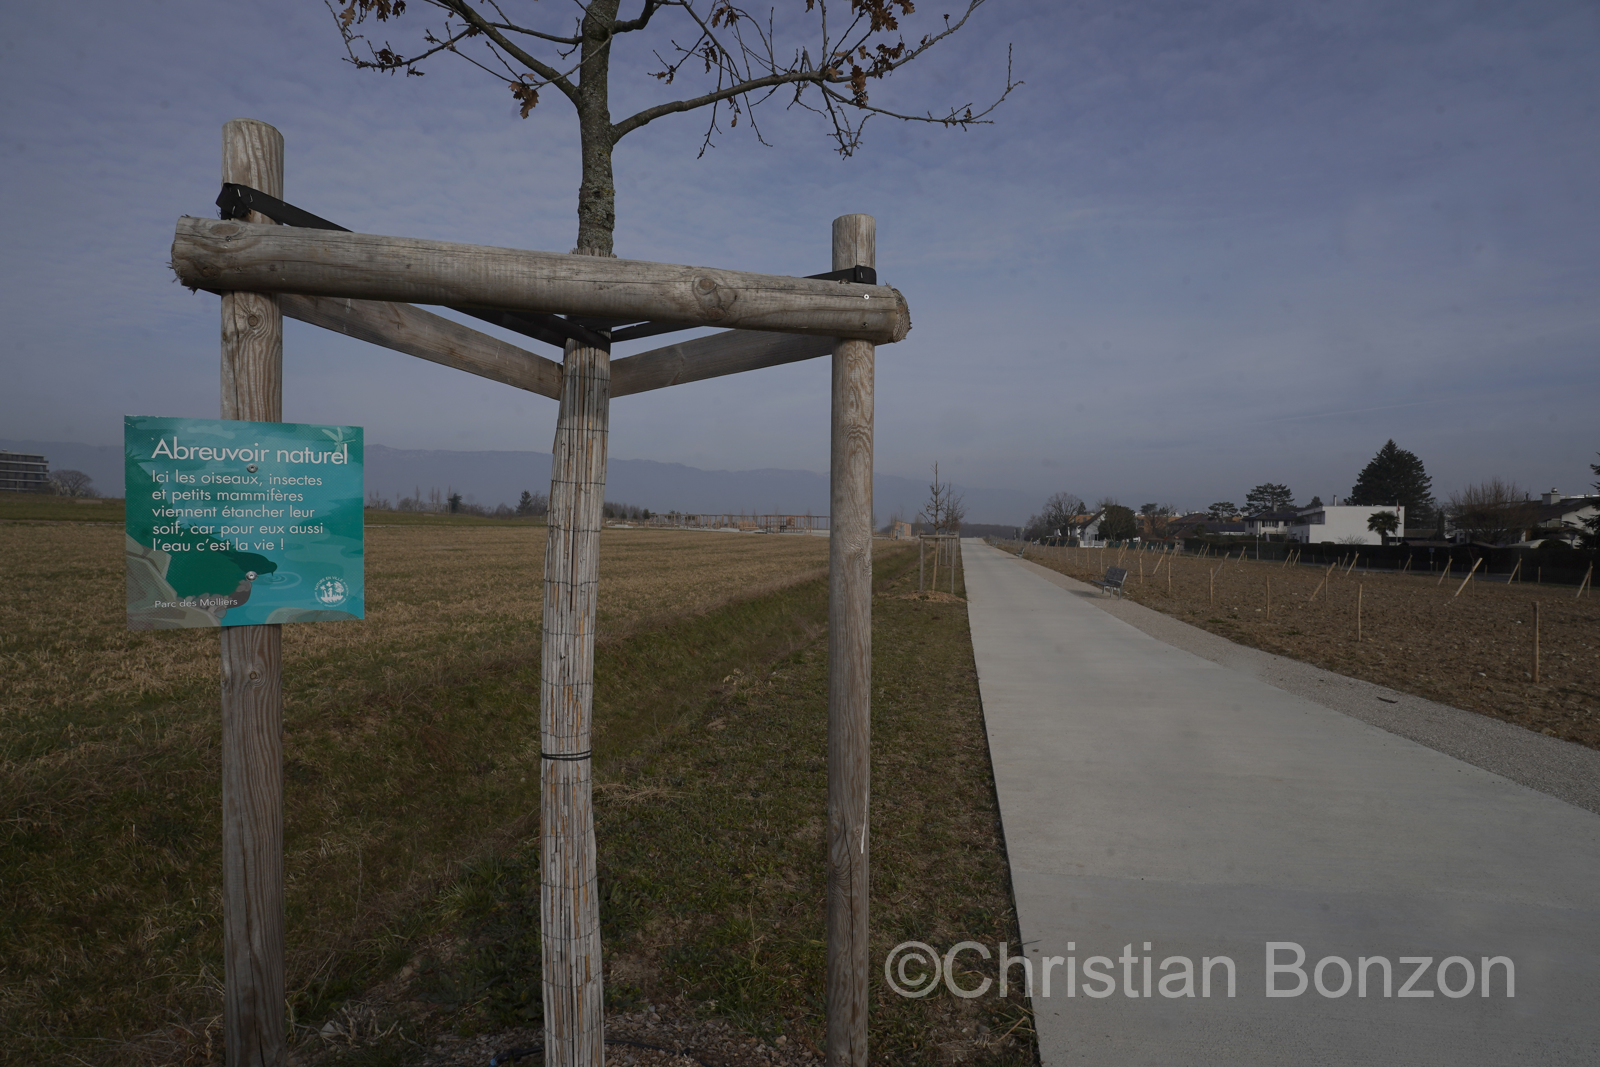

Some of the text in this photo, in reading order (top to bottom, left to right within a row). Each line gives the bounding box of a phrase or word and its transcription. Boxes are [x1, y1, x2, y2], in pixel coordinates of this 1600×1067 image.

[151, 436, 349, 465] Abreuvoir naturel
[151, 470, 323, 487] Ici les oiseaux, insectes
[151, 487, 304, 503] et petits mammifères
[152, 505, 315, 518] viennent étancher leur
[152, 521, 324, 538] soif, car pour eux aussi
[235, 538, 249, 551] la
[253, 539, 275, 551] vie
[280, 538, 284, 551] !
[154, 598, 238, 608] Parc des Molliers
